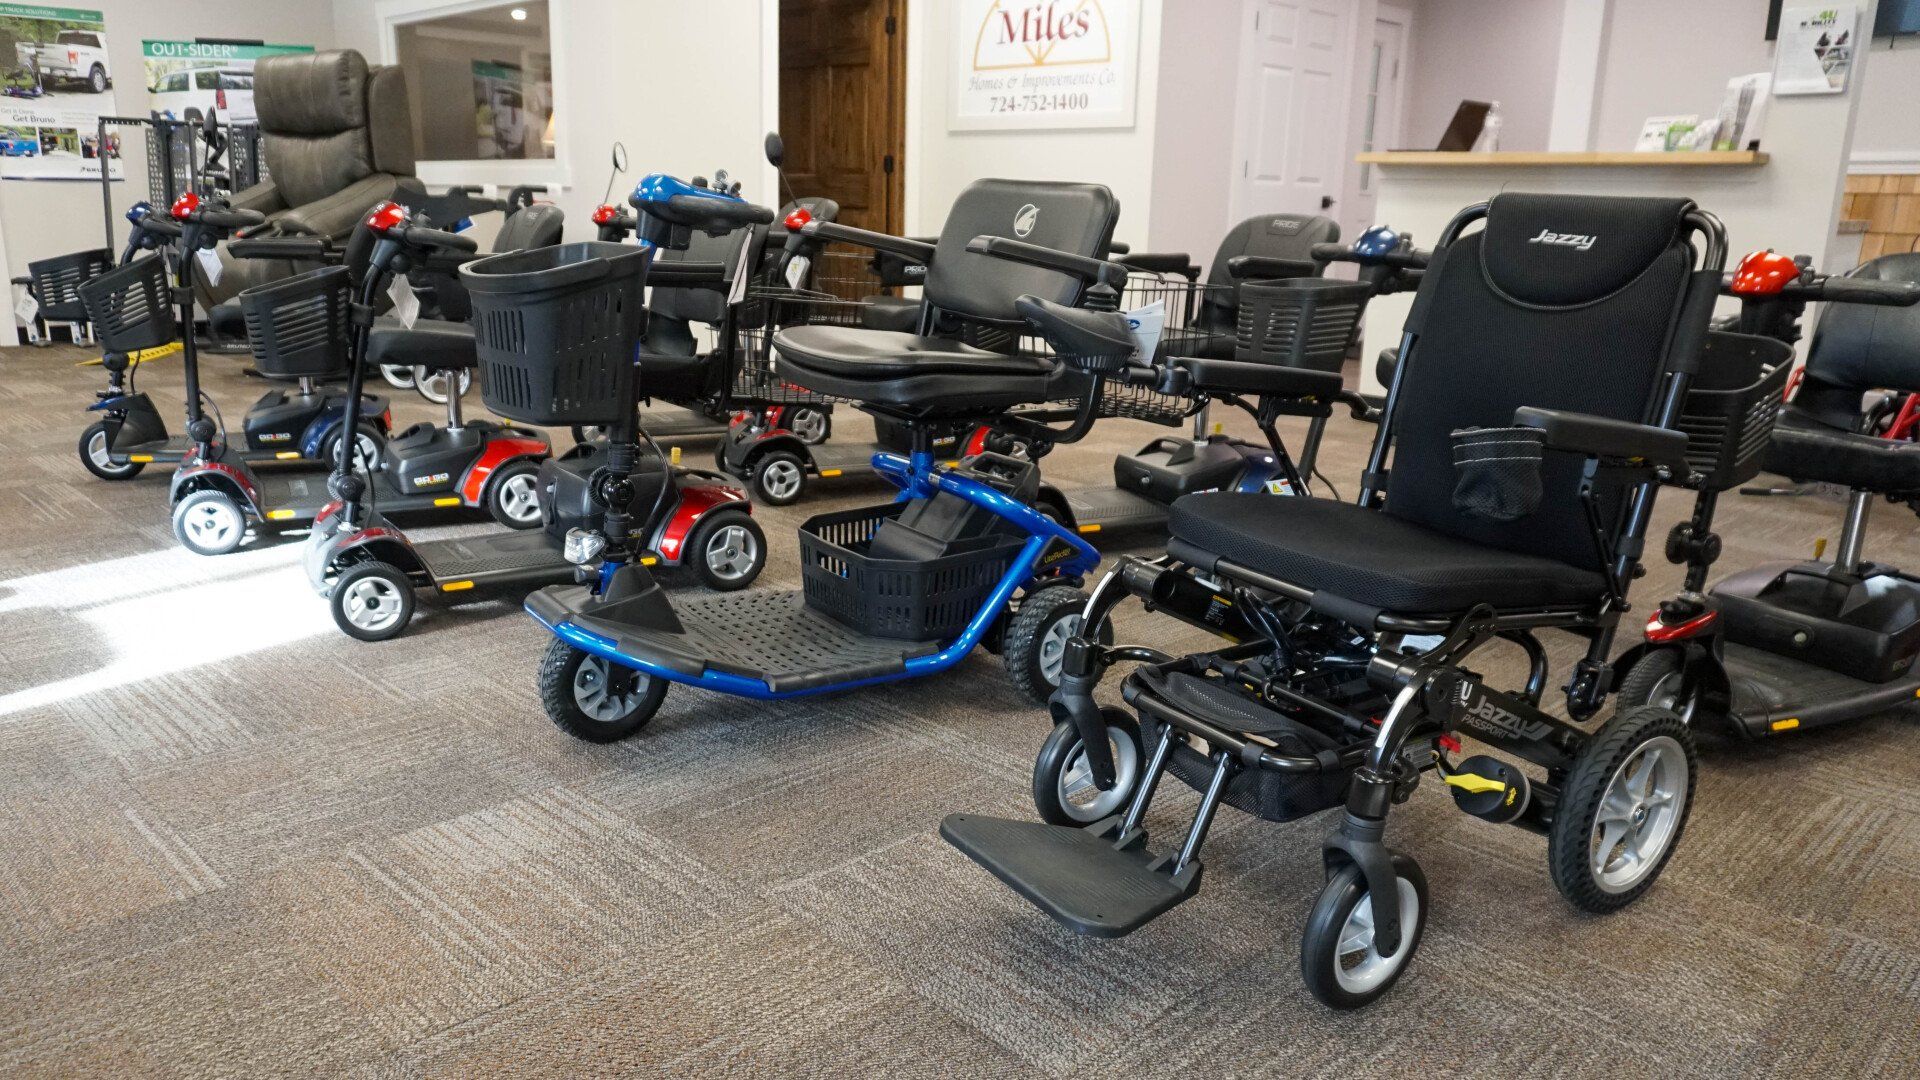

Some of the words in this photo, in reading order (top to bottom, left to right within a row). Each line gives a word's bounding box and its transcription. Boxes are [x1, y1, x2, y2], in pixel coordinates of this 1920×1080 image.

[996, 3, 1090, 45] Miles
[968, 75, 1004, 92] Homes
[1022, 73, 1096, 93] Improvements
[990, 92, 1089, 113] 724-752-1400
[13, 115, 29, 123] Get
[30, 115, 56, 124] Bruno
[1528, 229, 1597, 251] Jazzy
[1462, 714, 1509, 740] PASSPORT
[1468, 695, 1528, 740] Jazzy
